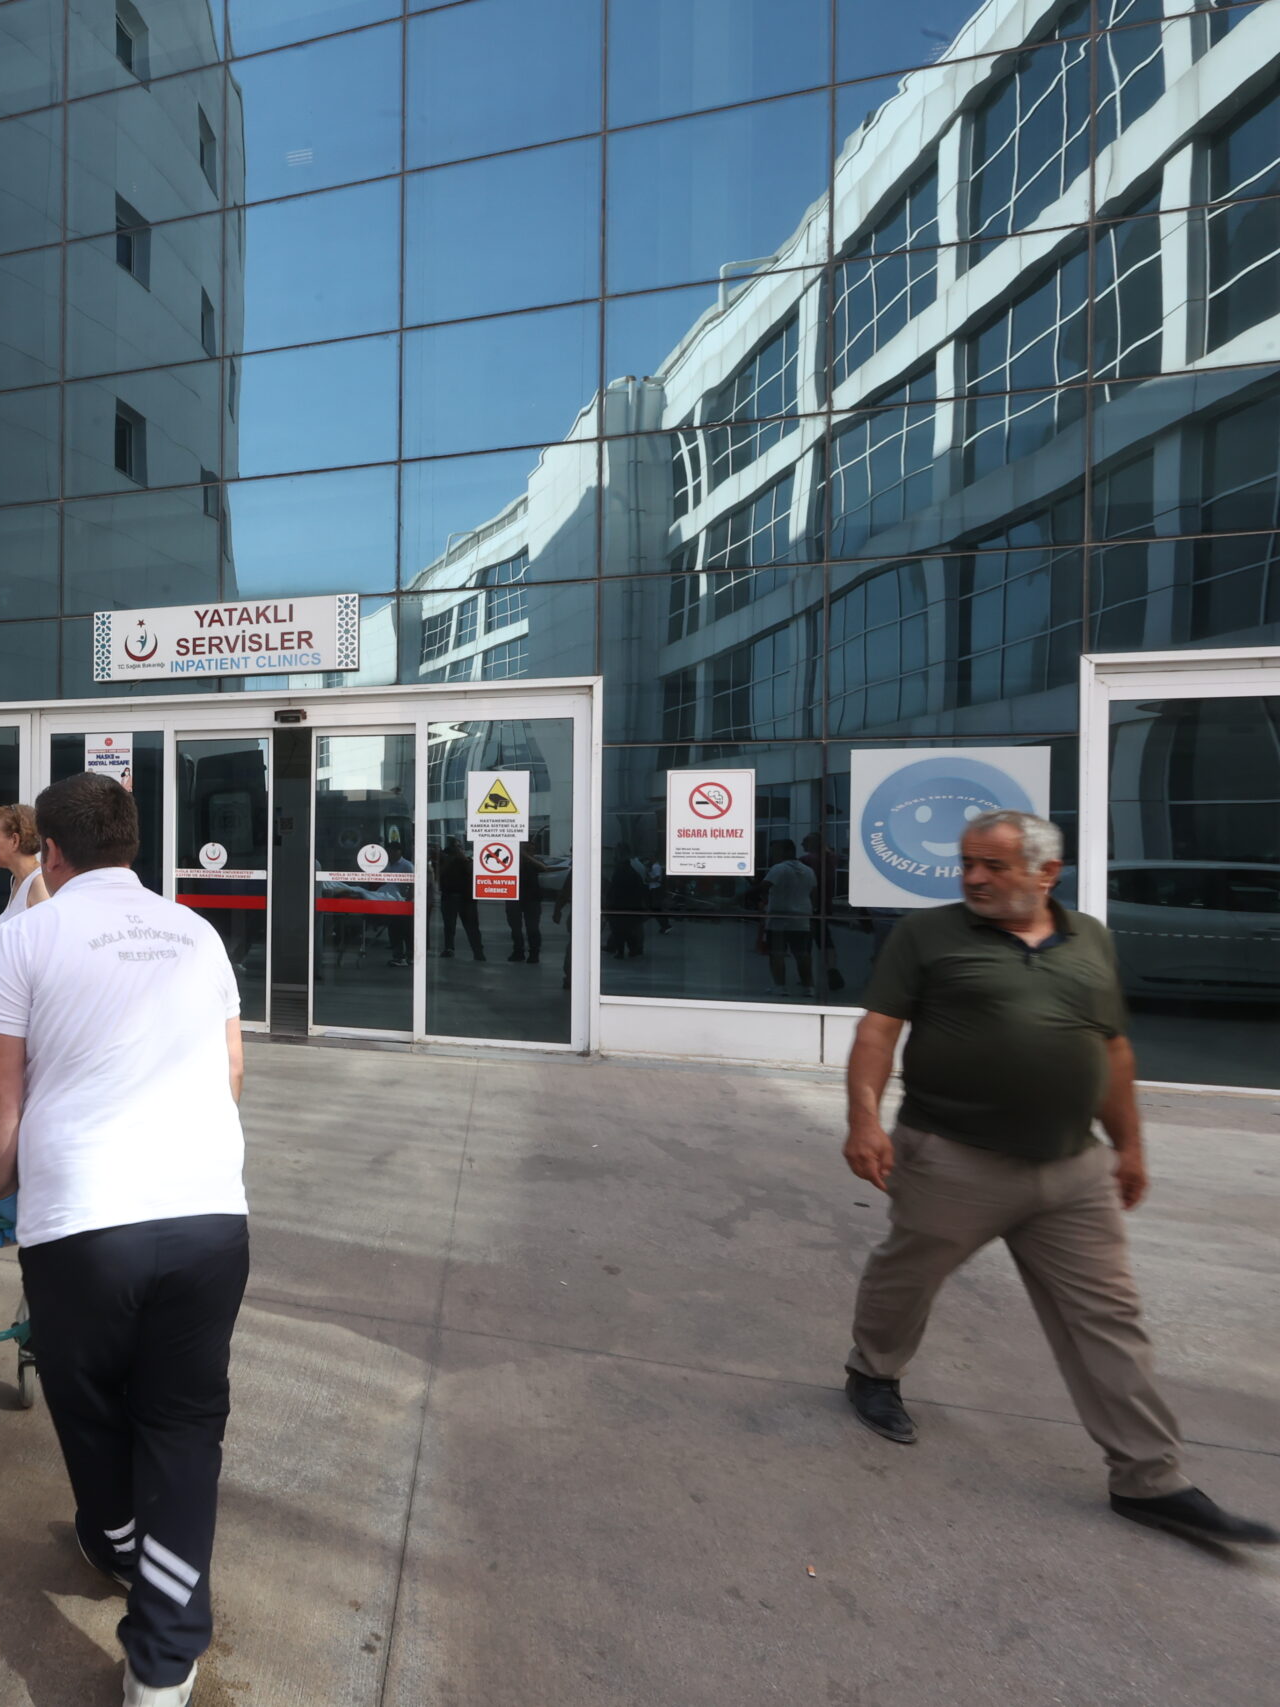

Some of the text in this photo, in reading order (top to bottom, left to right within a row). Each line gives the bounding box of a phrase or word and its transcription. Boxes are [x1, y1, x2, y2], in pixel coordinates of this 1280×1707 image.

[194, 604, 294, 628] YATAKLI
[176, 630, 313, 656] SERVİSLER
[170, 653, 321, 673] INPATIENT CLINICS
[978, 799, 1002, 809] ZON
[677, 826, 744, 840] SİGARA İÇİLMEZ
[870, 832, 964, 877] DUMANSIZ HA
